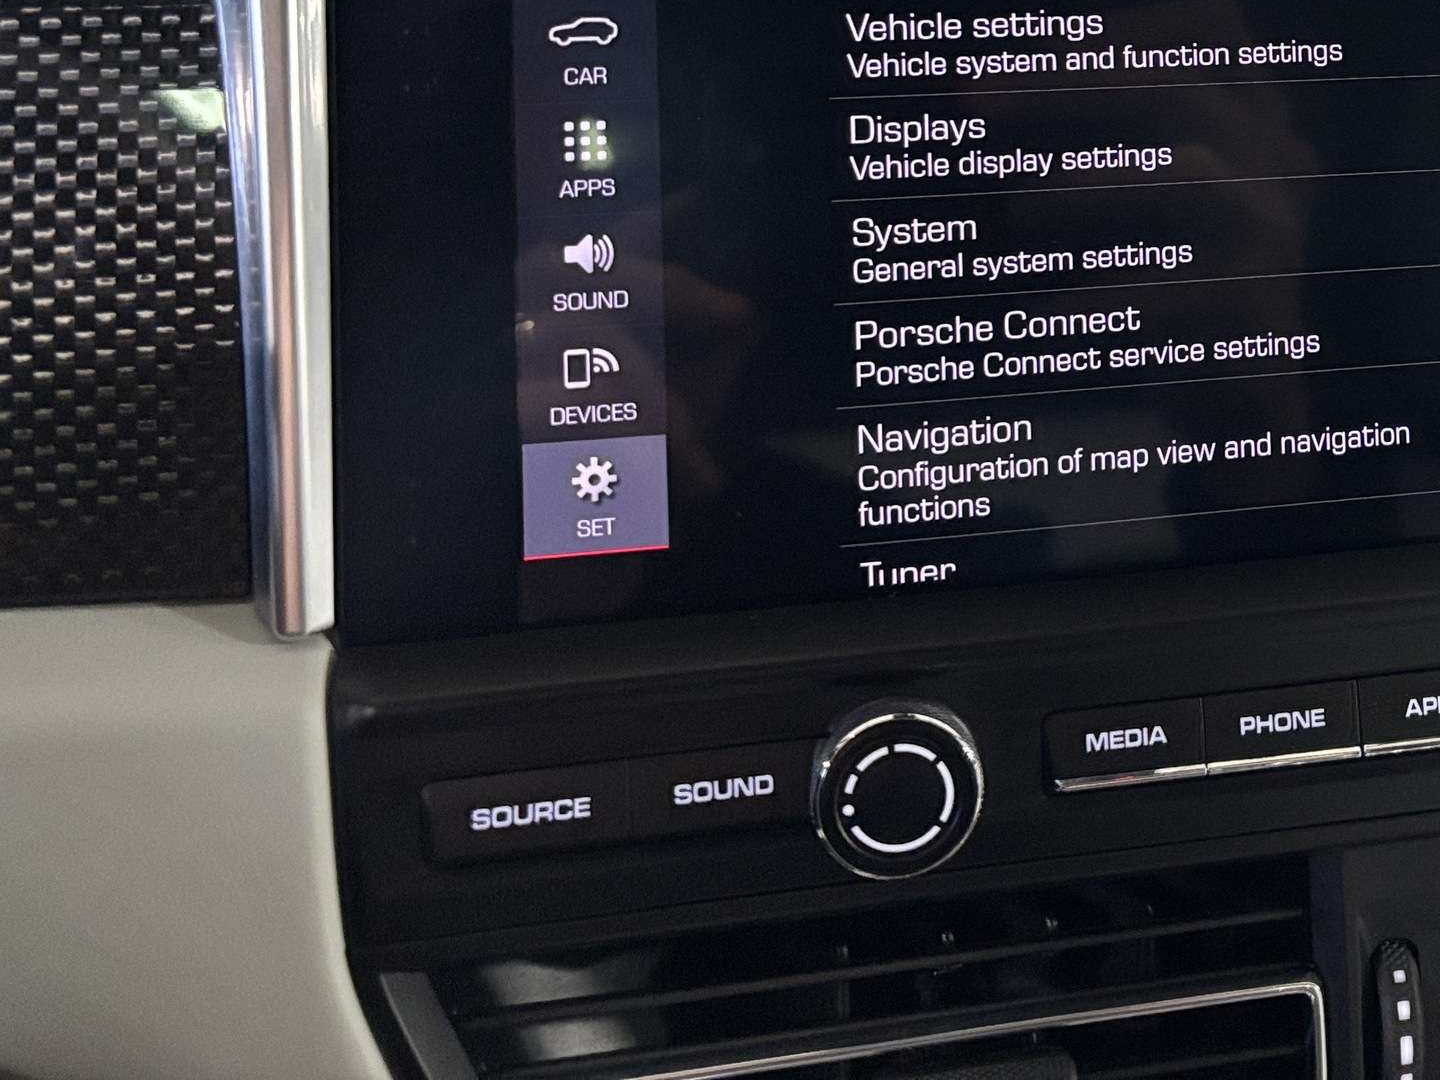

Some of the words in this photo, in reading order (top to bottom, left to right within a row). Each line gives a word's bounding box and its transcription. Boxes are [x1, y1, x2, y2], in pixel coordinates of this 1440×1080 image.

[846, 12, 962, 41] Vehicle
[973, 10, 1103, 41] settings
[847, 51, 946, 78] Vehicle
[956, 52, 1056, 79] system
[1066, 46, 1114, 70] and
[1123, 43, 1229, 68] function
[1239, 40, 1342, 66] settings
[564, 67, 607, 85] CAR
[850, 114, 985, 148] Displays
[850, 153, 949, 180] Vehicle
[959, 149, 1053, 178] display
[1062, 144, 1172, 171] settings
[559, 178, 615, 198] APPS
[853, 218, 976, 251] System
[853, 253, 963, 283] General
[973, 252, 1073, 280] system
[1083, 242, 1192, 269] settings
[553, 291, 628, 311] SOUND
[856, 316, 993, 350] Porsche
[1005, 307, 1140, 339] Connect
[856, 356, 974, 387] Porsche
[984, 348, 1101, 377] Connect
[1110, 339, 1204, 367] service
[1214, 332, 1320, 359] settings
[550, 403, 637, 425] DEVICES
[858, 416, 1031, 454] Navigation
[859, 450, 1048, 491] Configuration
[1058, 448, 1083, 473] of
[1091, 449, 1148, 472] map
[1157, 440, 1216, 465] view
[1225, 432, 1271, 459] and
[1281, 423, 1410, 455] navigation
[859, 495, 990, 526] functions
[577, 518, 616, 537] SET
[1240, 709, 1325, 735] PHONE
[1086, 726, 1167, 752] MEDIA
[674, 775, 773, 804] SOUND
[471, 797, 591, 830] SOURCE
